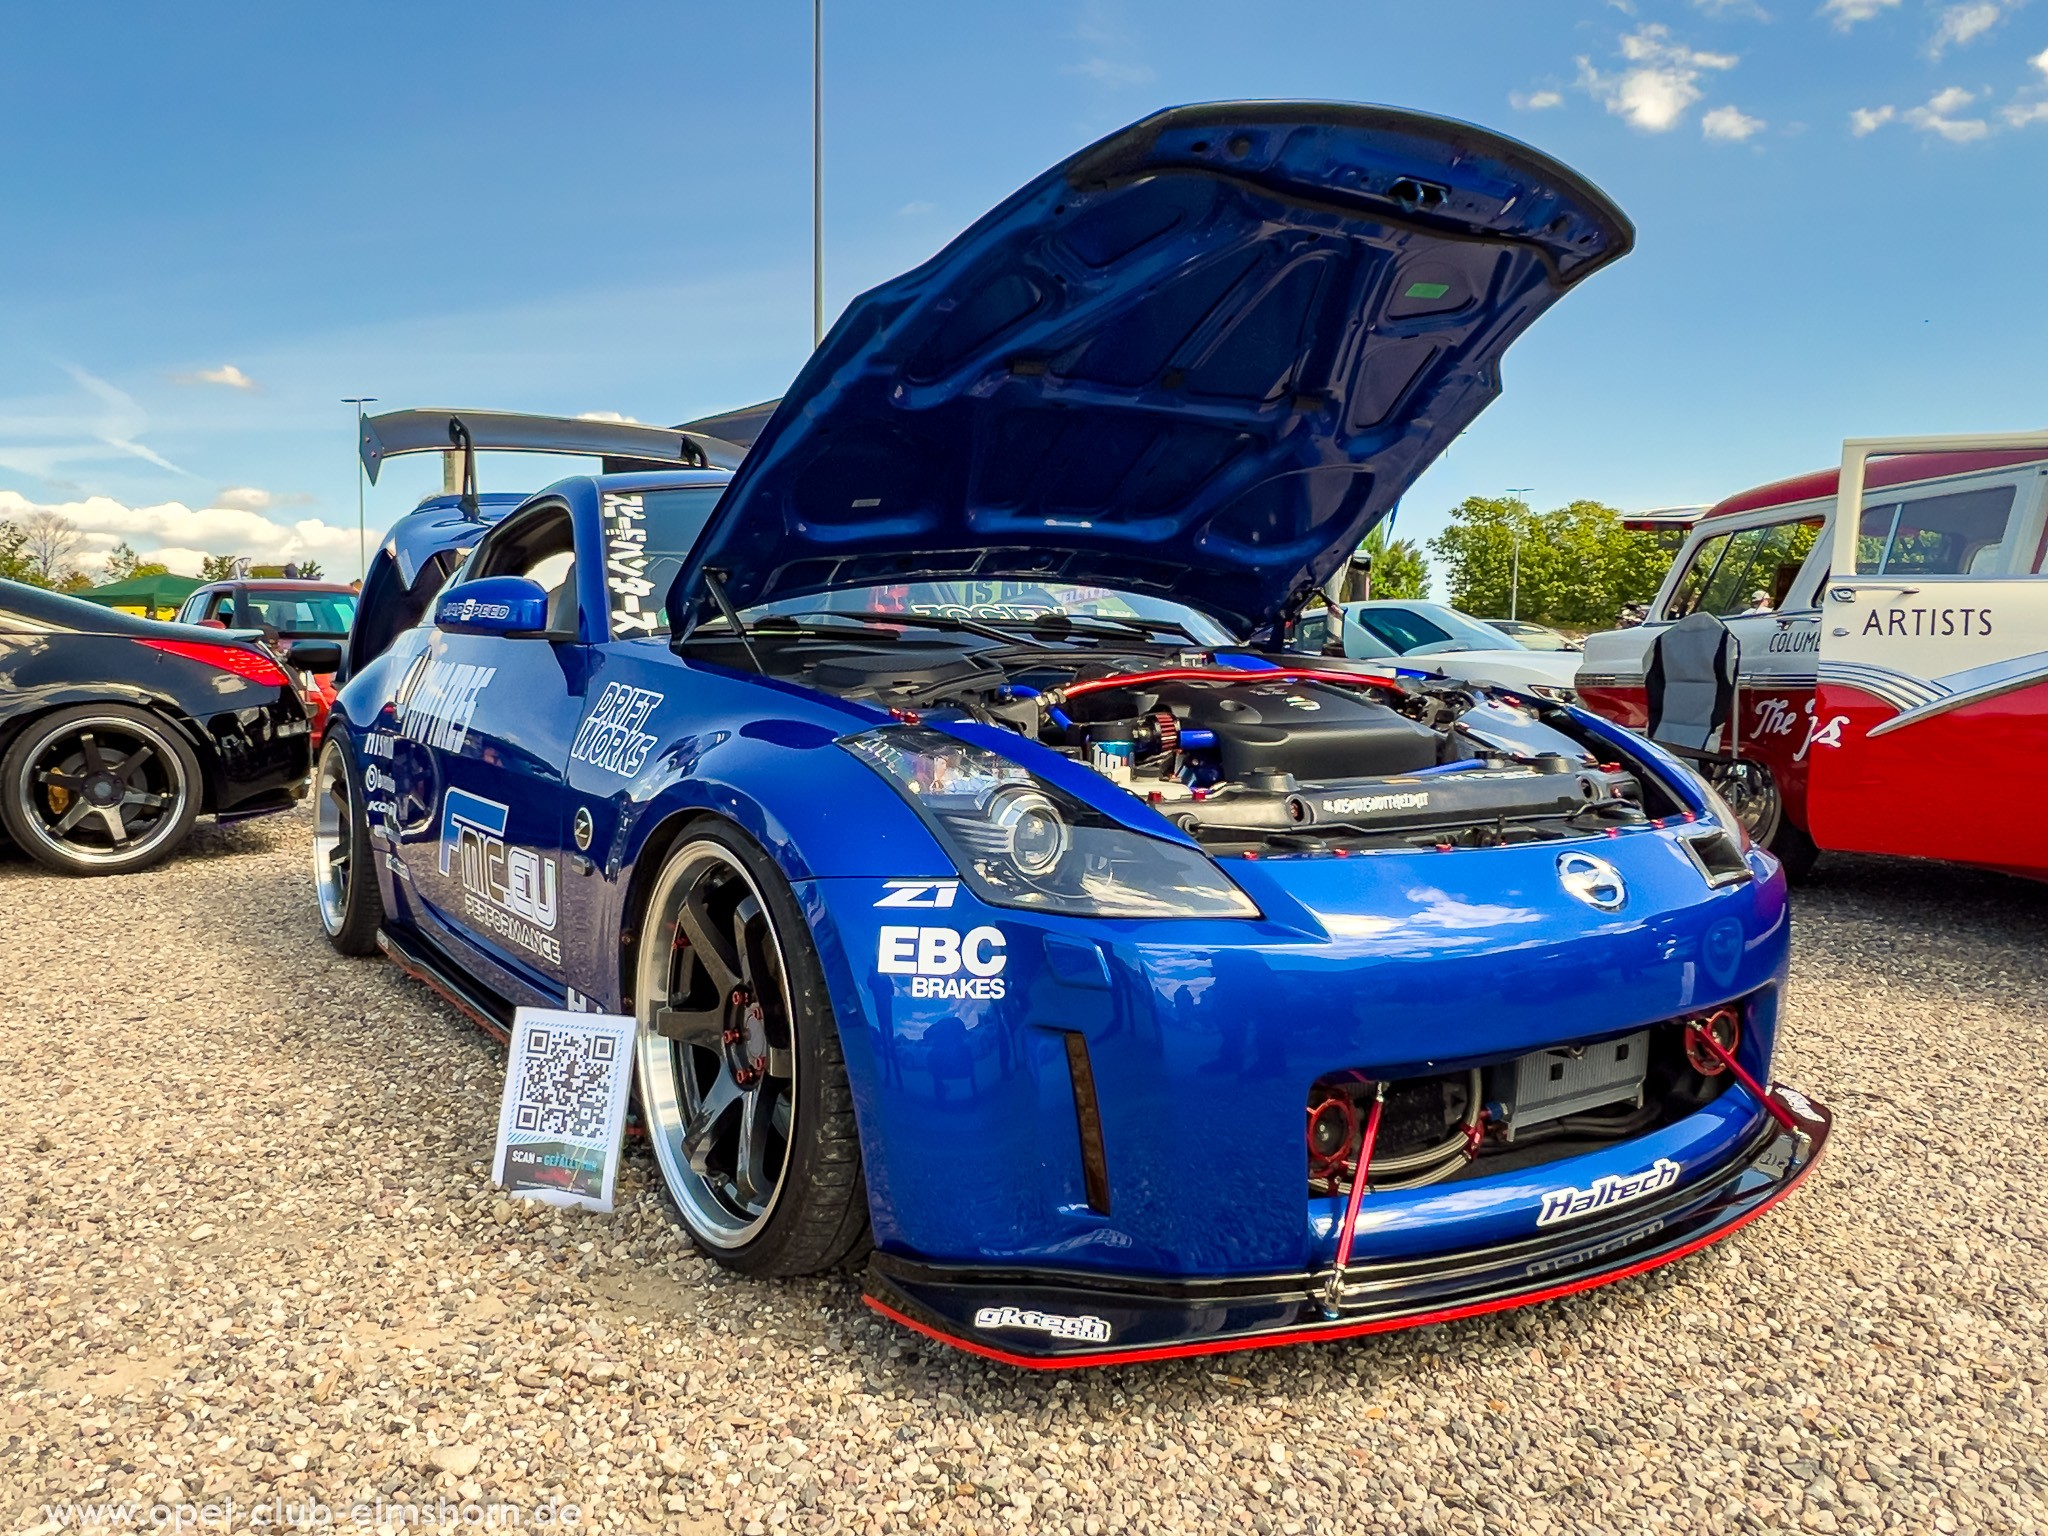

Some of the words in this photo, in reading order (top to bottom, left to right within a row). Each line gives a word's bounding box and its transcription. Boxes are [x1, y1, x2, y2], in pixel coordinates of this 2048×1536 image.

[443, 599, 510, 621] JAPSPEED
[1862, 609, 1993, 636] ARTISTS
[591, 681, 665, 734] DRIFT
[1750, 698, 1797, 739] The
[570, 716, 659, 779] WORKS
[465, 893, 562, 966] PERFORMANCE
[877, 925, 1007, 977] EBC
[911, 976, 1006, 1000] BRAKES
[512, 1150, 535, 1164] SCAN
[1538, 1159, 1681, 1226] Haltech
[975, 1307, 1112, 1342] gktech
